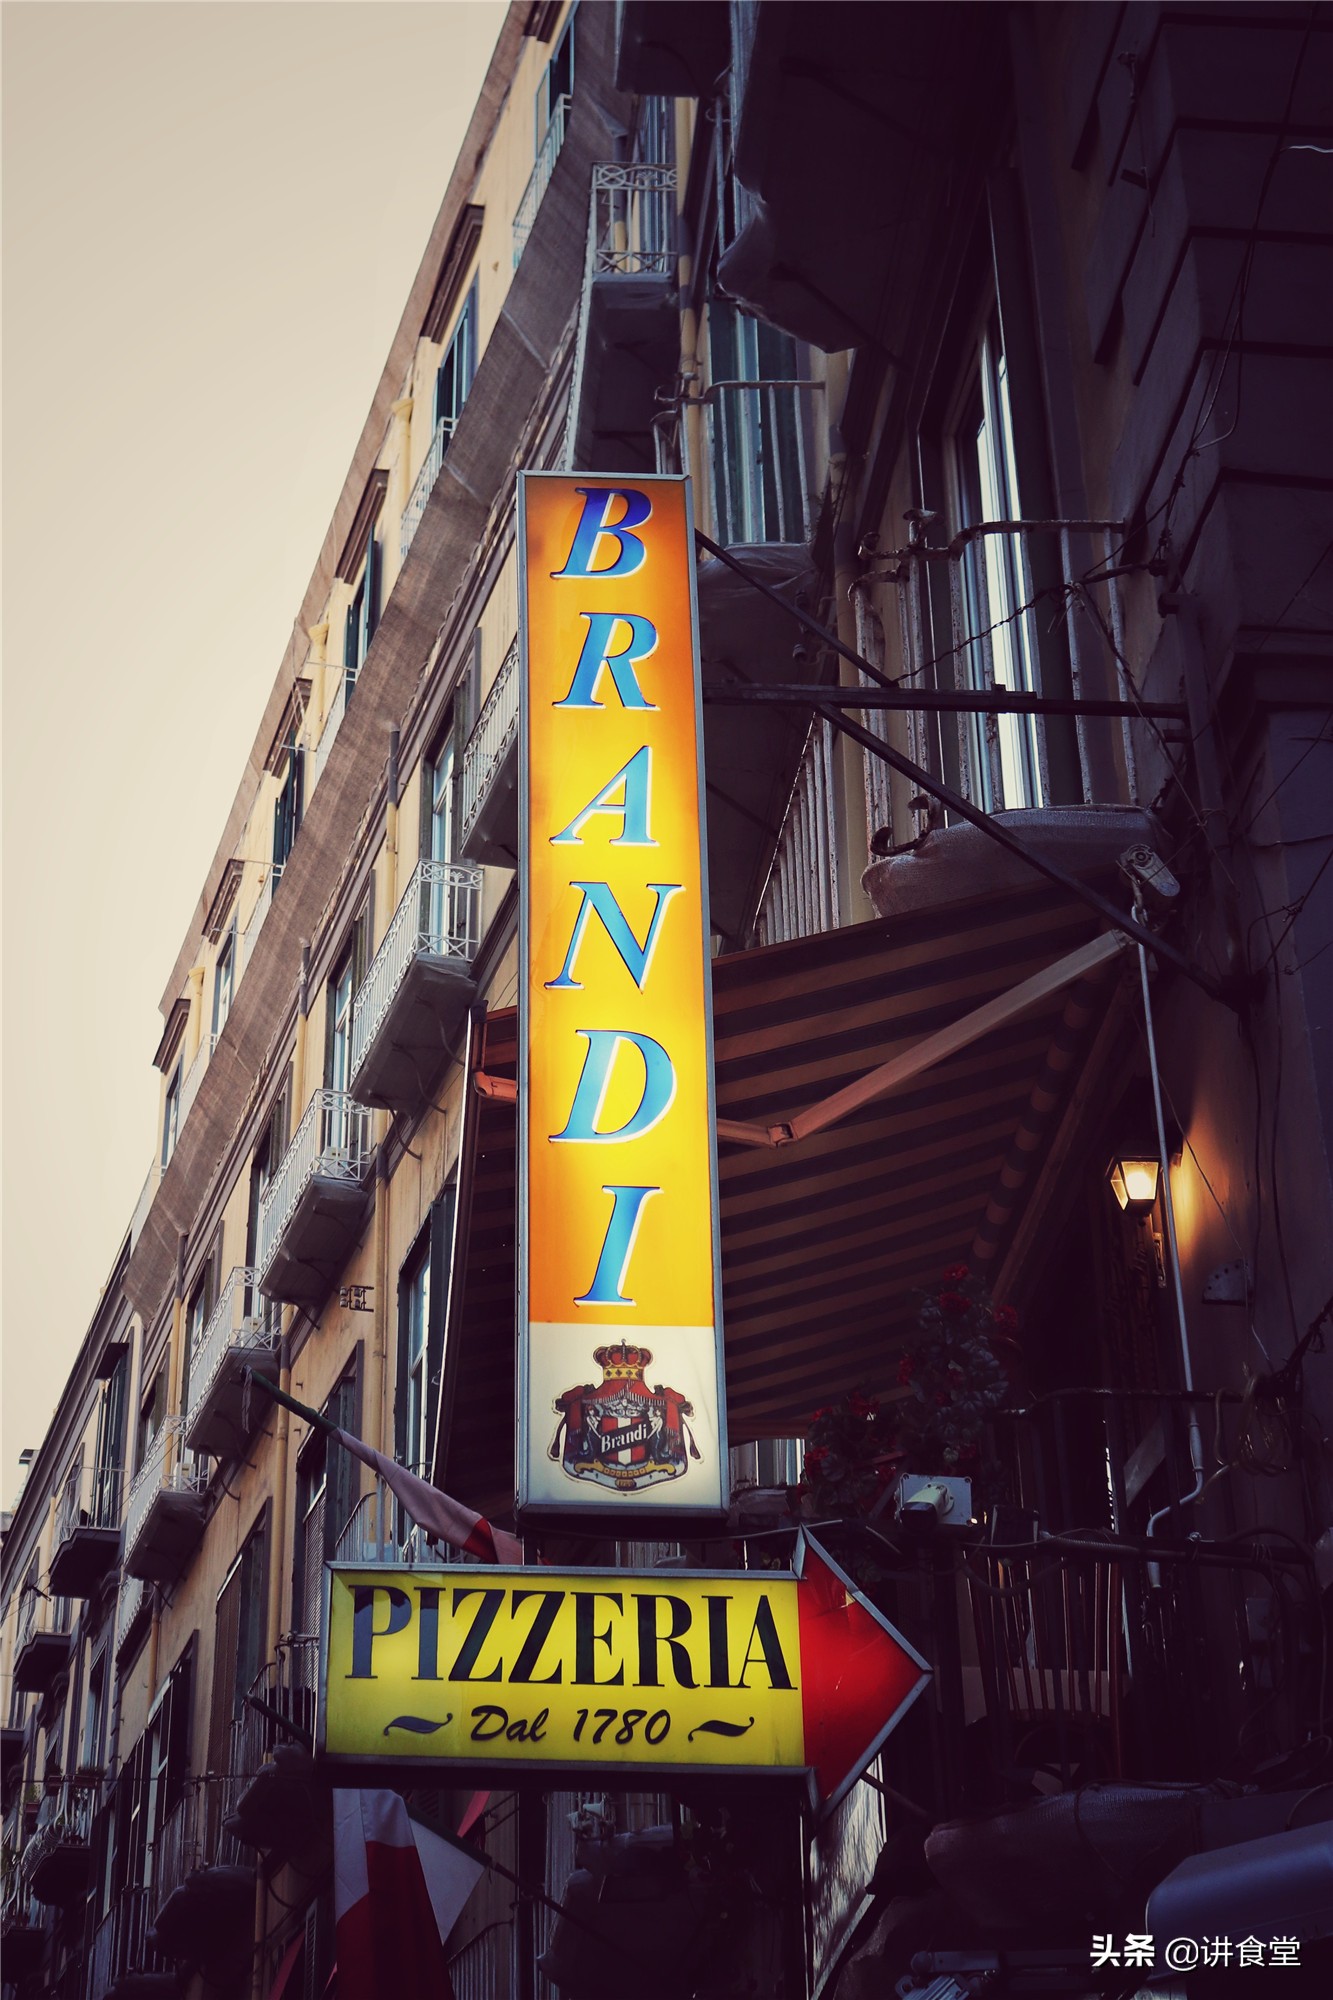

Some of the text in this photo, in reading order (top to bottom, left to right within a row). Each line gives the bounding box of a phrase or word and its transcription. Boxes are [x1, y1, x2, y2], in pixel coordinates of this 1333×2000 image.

[544, 487, 685, 1307] BRANDI
[601, 1423, 647, 1453] Brandi
[345, 1585, 798, 1690] PIZZERIA
[470, 1705, 671, 1745] Dal 1780
